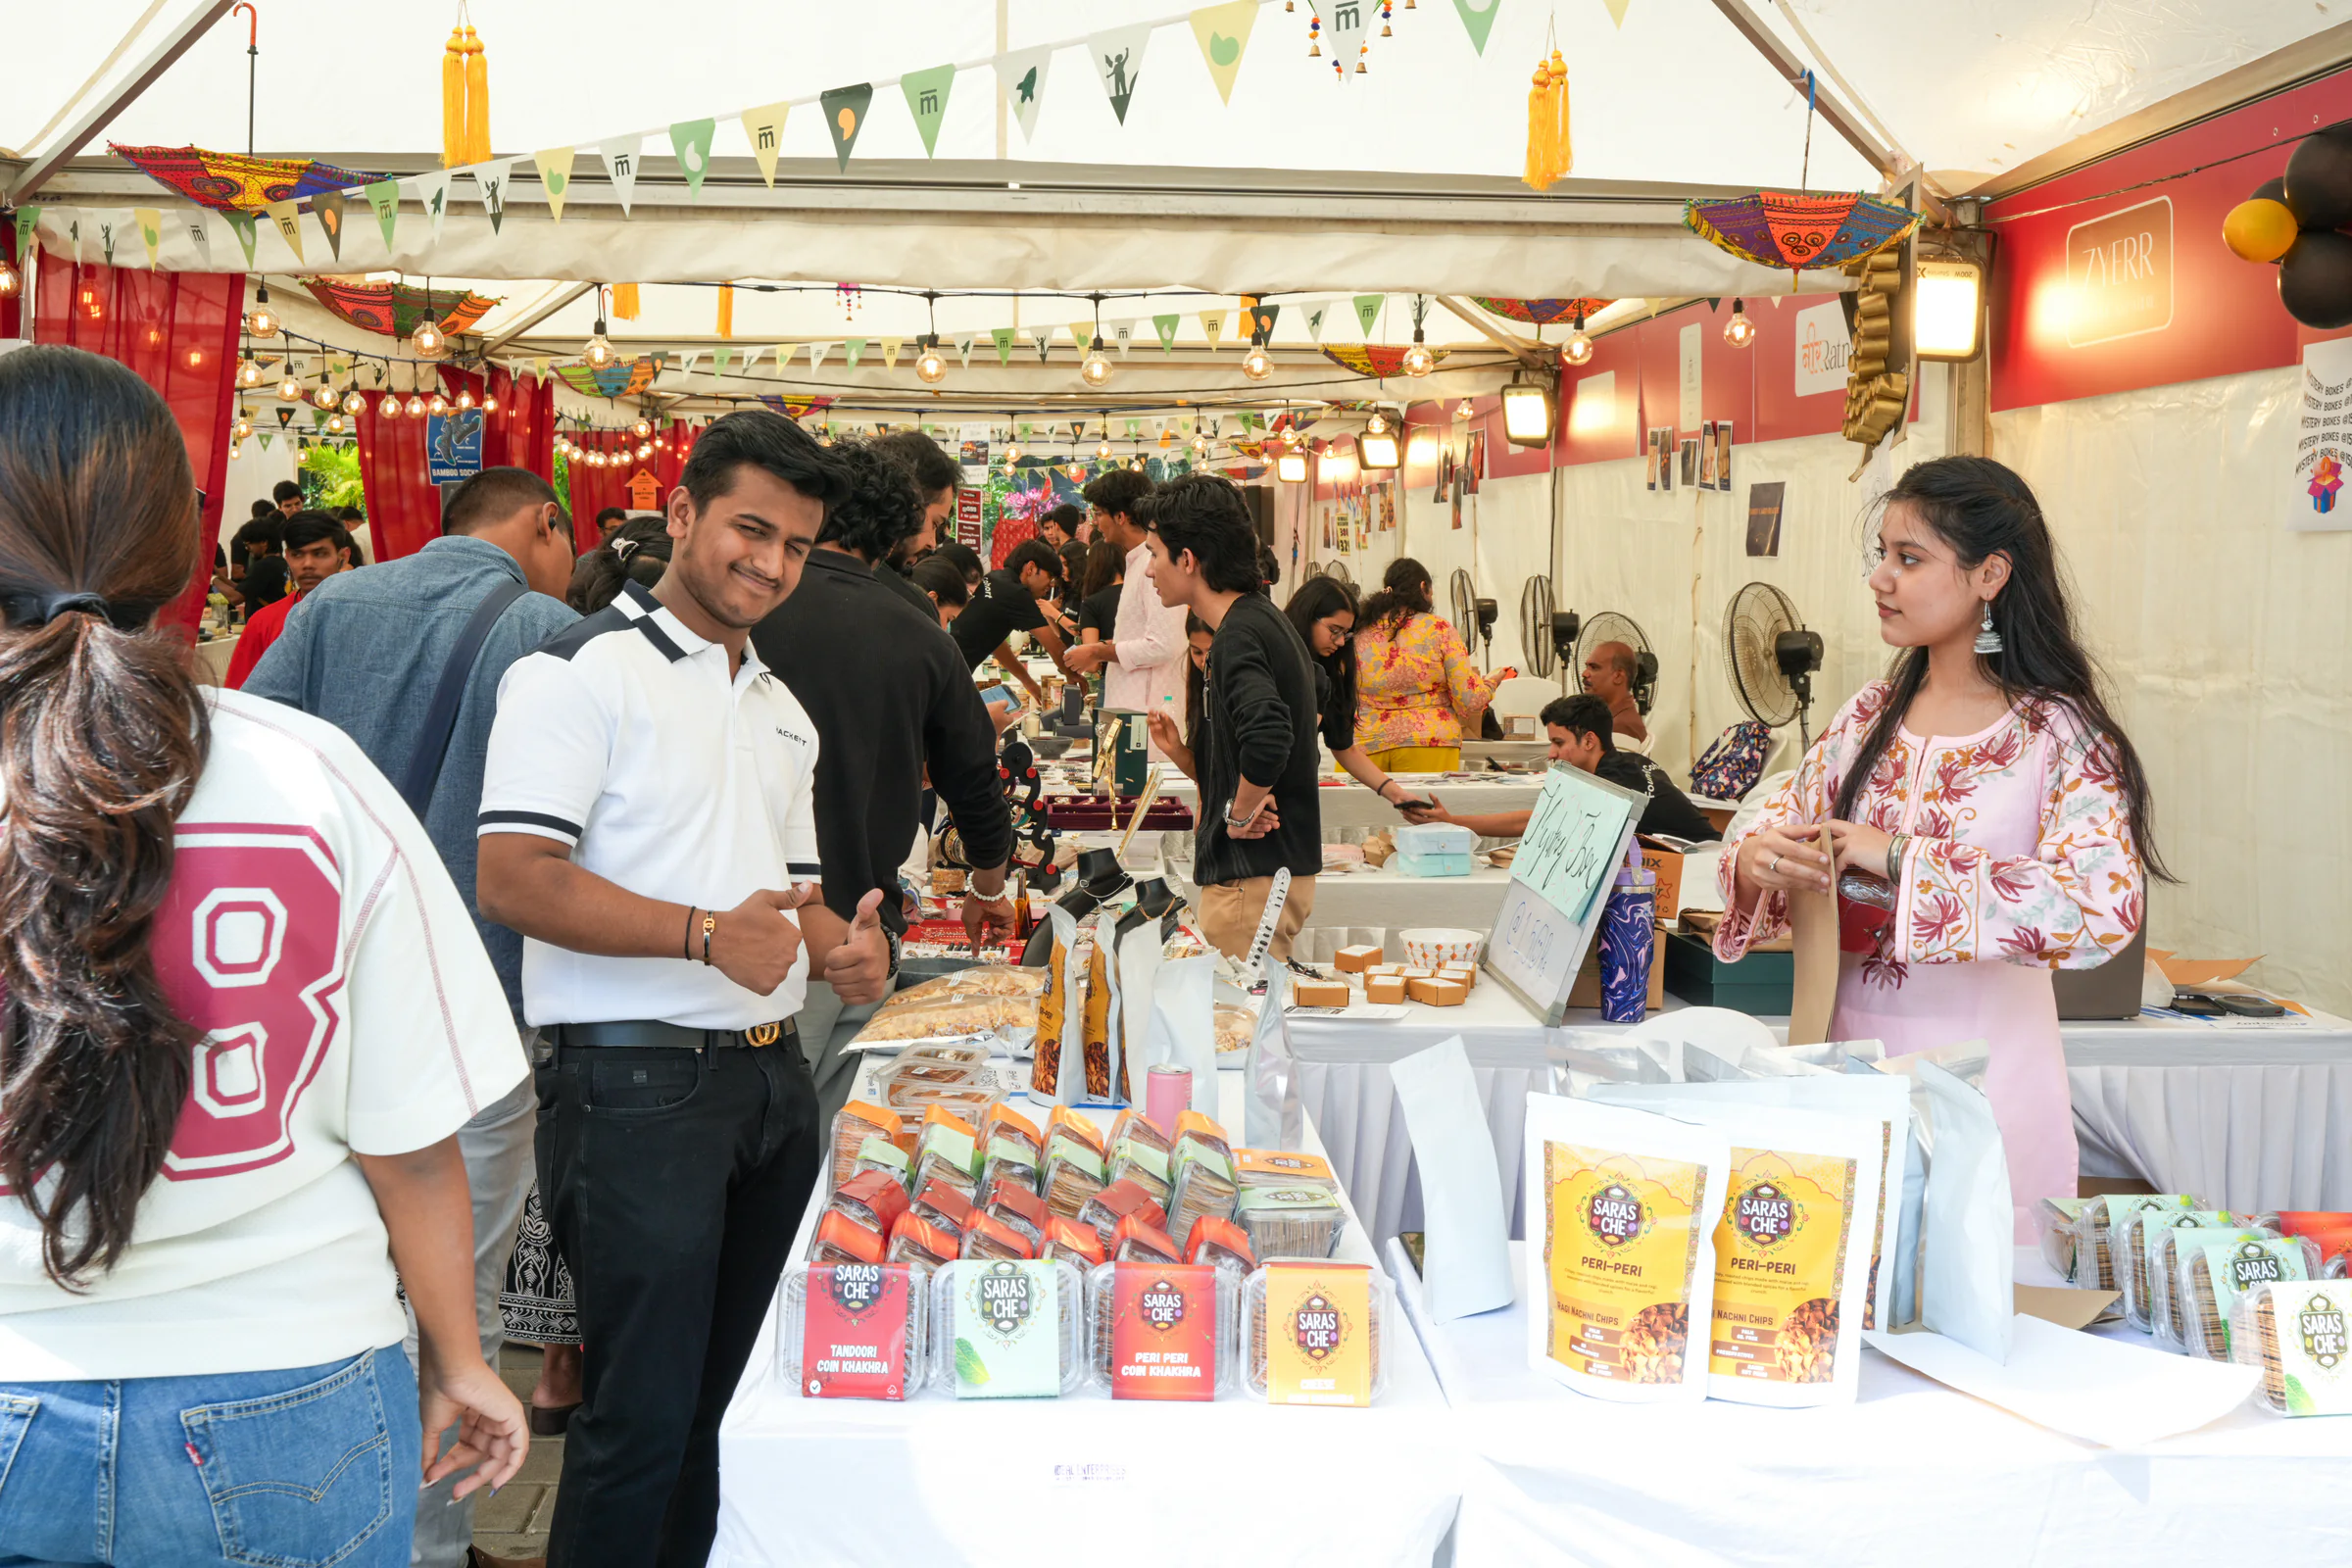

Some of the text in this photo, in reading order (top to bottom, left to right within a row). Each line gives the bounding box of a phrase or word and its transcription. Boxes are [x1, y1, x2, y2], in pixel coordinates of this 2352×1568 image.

[2325, 383, 2344, 396] BOXES
[2304, 391, 2323, 411] MYSTERY
[2324, 400, 2342, 411] BOXES
[2301, 416, 2321, 429] MYSTERY
[2323, 416, 2340, 427] BOXES
[2298, 435, 2320, 454] MYSTERY
[2321, 432, 2339, 443] BOXES
[2295, 451, 2318, 478] MYSTERY
[2320, 447, 2337, 458] BOXES
[1593, 1199, 1637, 1221] SARAS
[1741, 1199, 1788, 1219] SARAS
[1600, 1217, 1627, 1236] CHE
[1750, 1216, 1778, 1235] CHE
[835, 1264, 879, 1283] SARAS
[1581, 1255, 1642, 1278] PERI-PERI
[1731, 1257, 1795, 1275] PERI-PERI
[2236, 1259, 2278, 1280] SARAS
[844, 1282, 870, 1299] CHE
[984, 1278, 1026, 1298] SARAS
[994, 1298, 1019, 1318] CHE
[1144, 1294, 1182, 1308] SARAS
[1152, 1307, 1174, 1321] CHE
[1298, 1313, 1336, 1330] SARAS
[2303, 1313, 2342, 1335] SARAS
[1307, 1330, 1330, 1348] CHE
[2314, 1335, 2339, 1354] CHE
[830, 1345, 878, 1358] TANDOORI
[1135, 1352, 1189, 1364] PERI PERI
[816, 1359, 889, 1374] COIN KHAKHRA
[1121, 1365, 1201, 1377] COIN KHAKHRA
